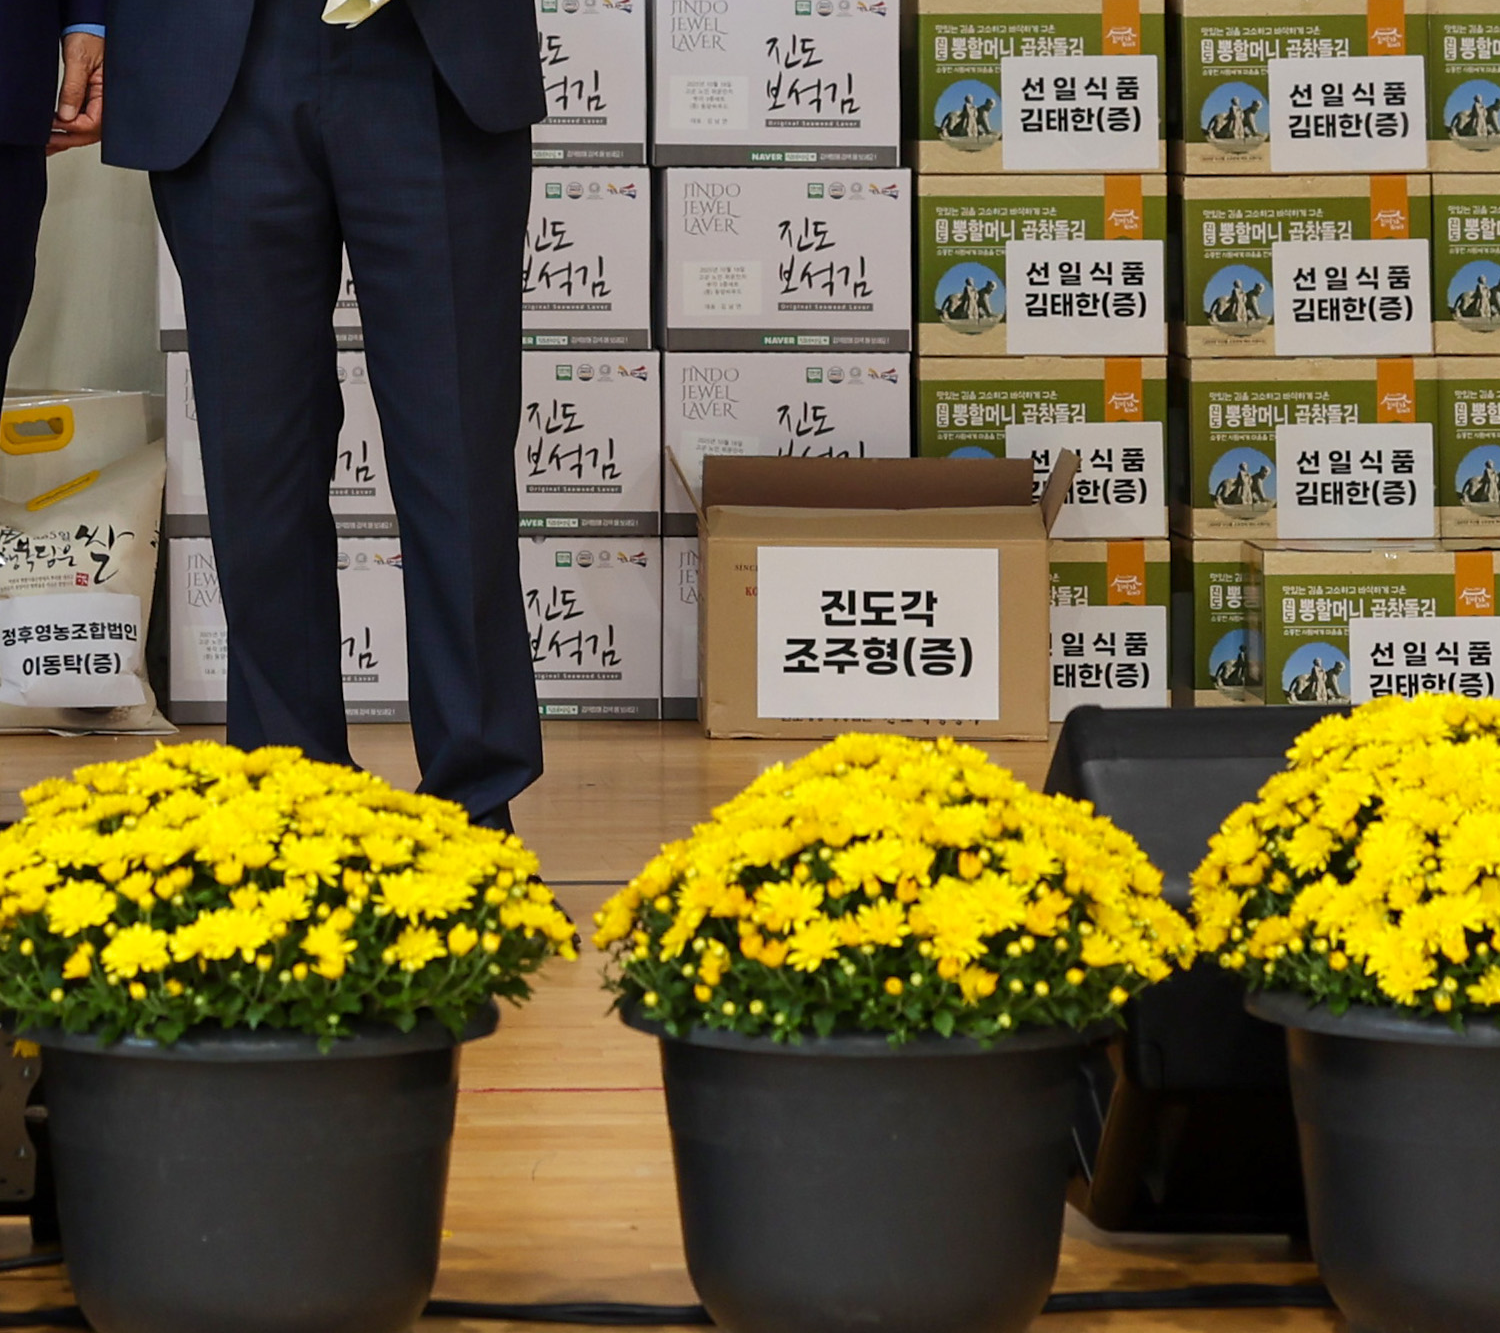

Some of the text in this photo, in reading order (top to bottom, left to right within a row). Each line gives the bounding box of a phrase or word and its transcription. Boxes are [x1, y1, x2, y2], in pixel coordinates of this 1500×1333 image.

[671, 16, 728, 35] JEWEL
[671, 34, 727, 52] LAVER
[767, 35, 822, 68] 진도
[1217, 36, 1350, 61] 뽕할머니 곱창돌김
[767, 73, 859, 113] 보석김
[1021, 106, 1141, 132] 김태한(증)
[1289, 112, 1408, 138] 김태한(증)
[752, 152, 783, 161] NAVER
[683, 182, 741, 199] JINDO
[683, 200, 741, 218] JEWEL
[683, 217, 739, 236] LAVER
[779, 218, 834, 251] 진도
[780, 256, 872, 297] 보석김
[1026, 292, 1146, 318] 김태한(증)
[1293, 296, 1412, 322] 김태한(증)
[764, 336, 796, 345] NAVER
[526, 398, 585, 434] 진도
[778, 402, 834, 436] 진도
[526, 436, 622, 480] 보석김
[1296, 480, 1416, 506] 김태한(증)
[526, 585, 585, 621] 진도
[821, 591, 937, 627] 진도각
[1299, 597, 1437, 621] 뽕할머니 곱창돌김
[2, 622, 138, 646] 정후영농조합법인
[22, 653, 121, 676] 이동탁(증)
[784, 638, 972, 677] 조주형(증)
